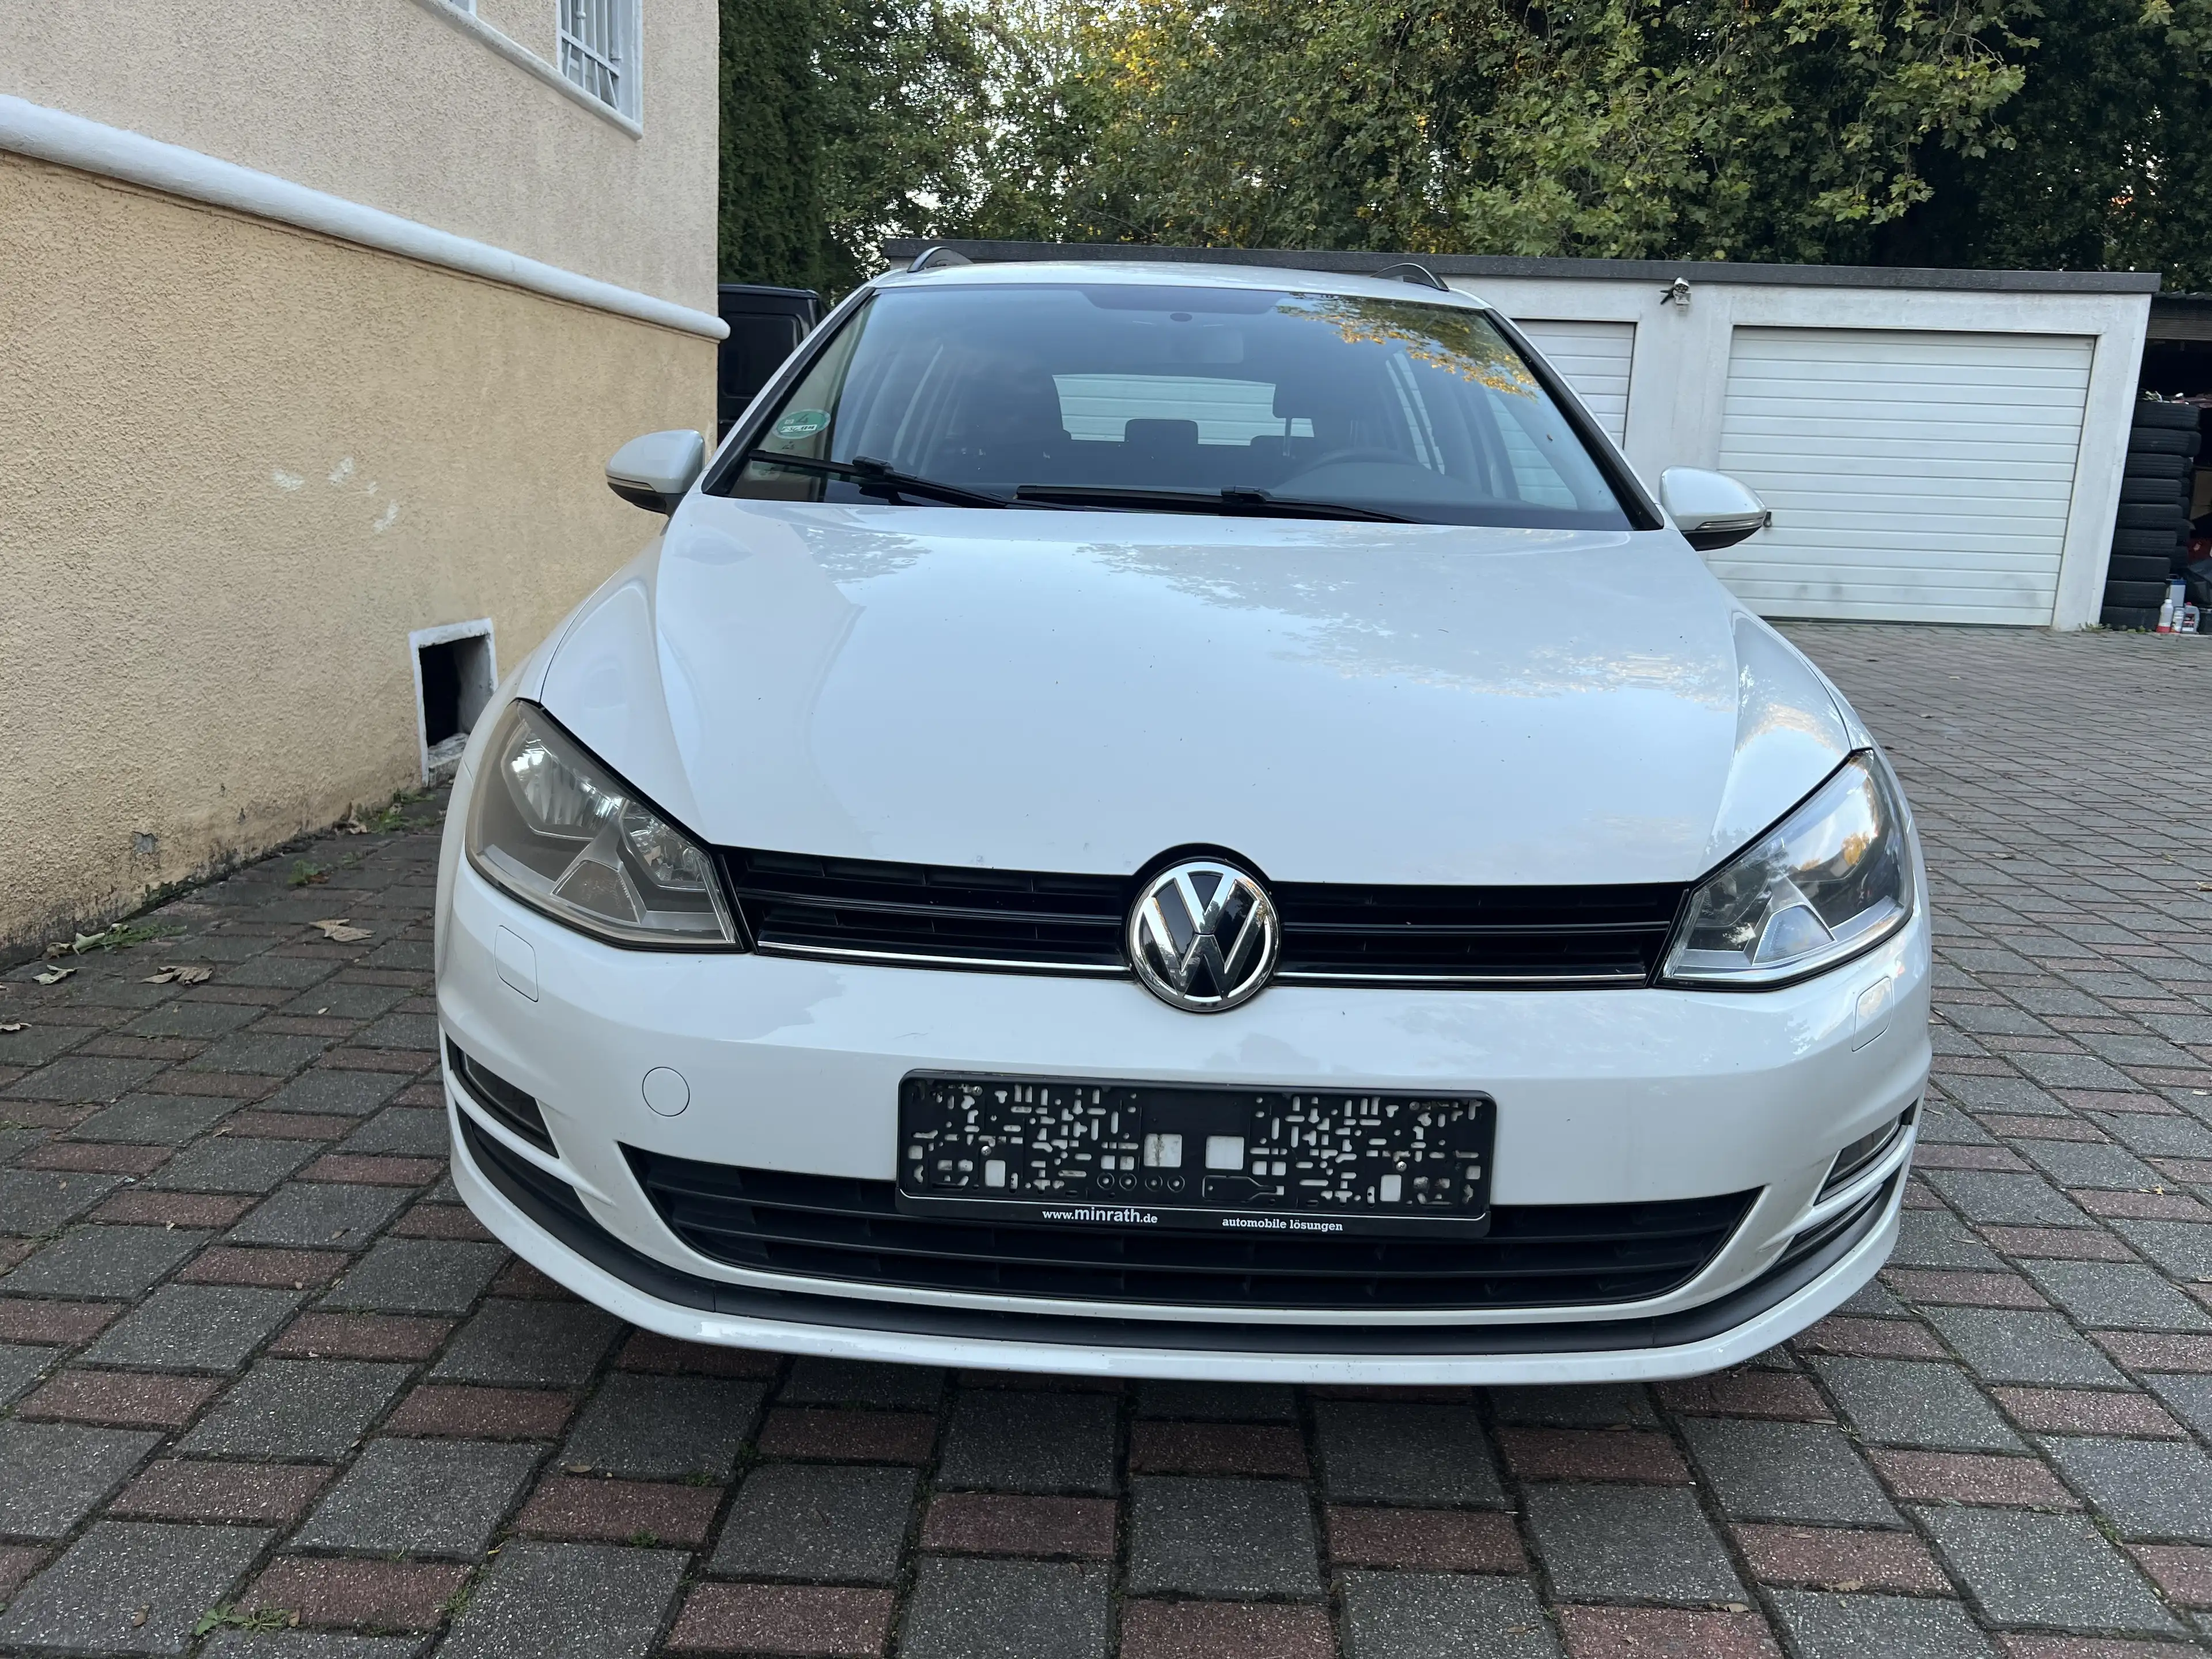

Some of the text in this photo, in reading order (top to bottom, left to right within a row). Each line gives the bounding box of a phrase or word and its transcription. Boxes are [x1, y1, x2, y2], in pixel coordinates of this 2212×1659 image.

[796, 413, 809, 424] 4
[1136, 865, 1272, 1003] VW
[1041, 1206, 1158, 1224] www.minrath.de
[1222, 1217, 1343, 1232] automobile lösungen
